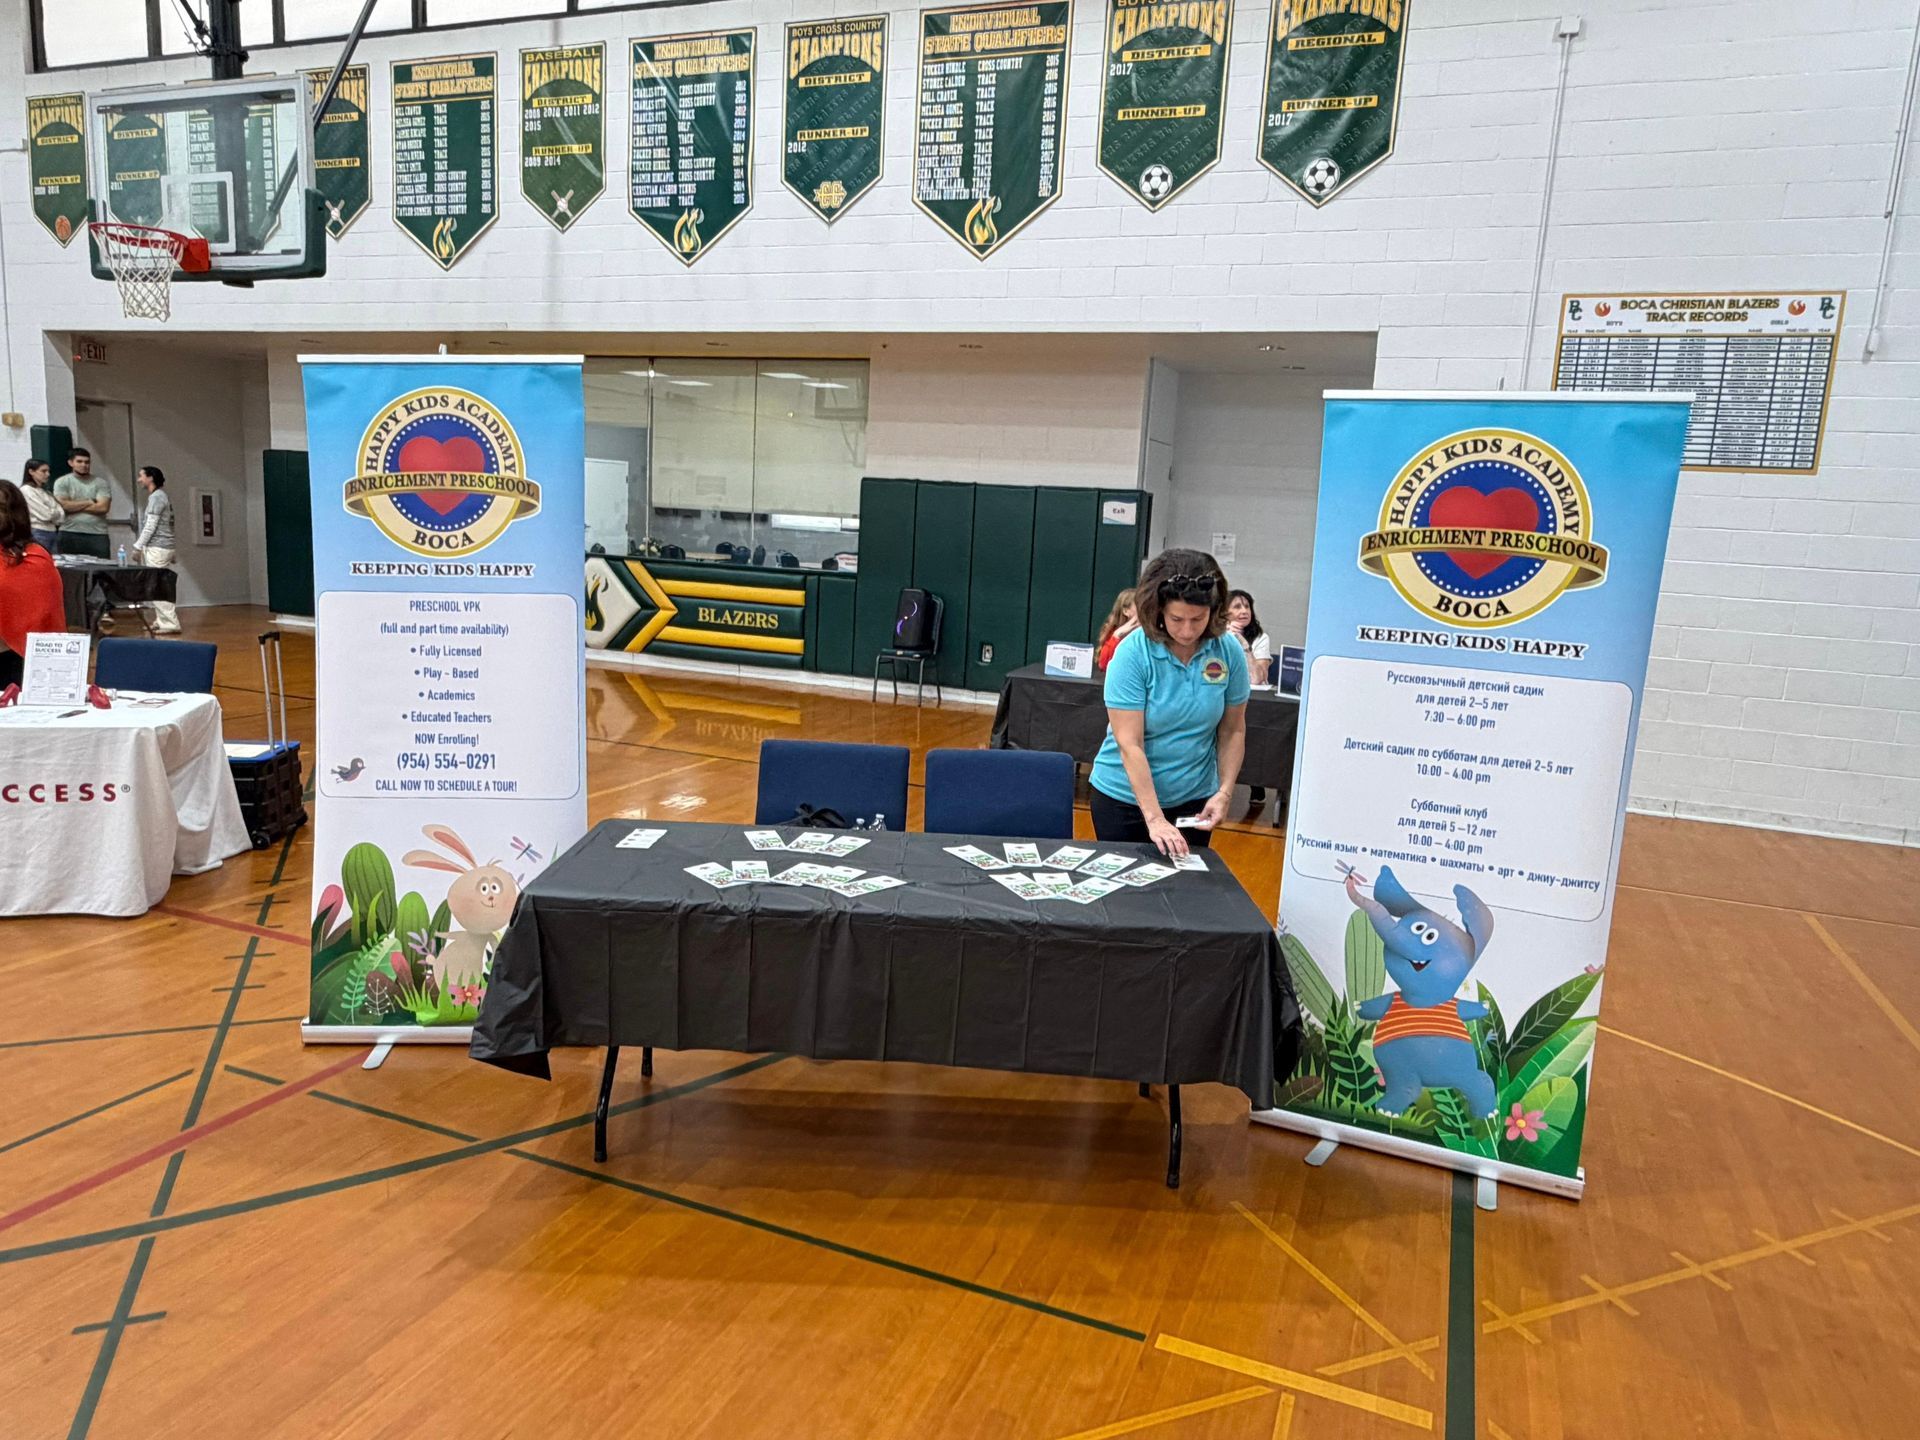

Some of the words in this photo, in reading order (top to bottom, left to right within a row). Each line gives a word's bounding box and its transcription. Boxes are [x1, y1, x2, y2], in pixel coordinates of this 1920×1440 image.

[951, 7, 1040, 32] INDIVIDUAL
[791, 26, 814, 37] BOYS
[815, 23, 842, 35] CROSS
[844, 20, 882, 33] COUNTRY
[1111, 0, 1226, 54] CHAMPIONS
[925, 35, 971, 54] STATE
[974, 25, 1066, 52] QUALIFIERS
[1295, 34, 1377, 48] REGIONAL
[526, 47, 600, 61] BASEBALL
[654, 39, 730, 60] INDIVIDUAL
[790, 31, 881, 80] CHAMPIONS
[1131, 46, 1202, 60] DISTRICT
[978, 59, 995, 71] CROSS
[997, 57, 1023, 70] COUNTRY
[1110, 63, 1133, 76] 2017
[524, 57, 601, 101] CHAMPIONS
[804, 73, 865, 86] DISTRICT
[978, 73, 997, 85] TRACK
[977, 87, 996, 99] TRACK
[536, 96, 587, 107] DISTRICT
[976, 101, 995, 113] TRACK
[1286, 97, 1373, 111] RUNNER-UP
[583, 104, 600, 115] 2012
[1122, 107, 1201, 119] RUNNER-UP
[1268, 113, 1293, 126] 2017
[524, 122, 542, 132] 2015
[799, 128, 867, 140] RUNNER-UP
[787, 142, 807, 153] 2012
[544, 156, 561, 166] 2014
[1619, 300, 1657, 311] BOCA
[1660, 299, 1725, 310] CHRISTIAN
[1728, 298, 1780, 310] BLAZERS
[1646, 312, 1687, 322] TRACK
[1689, 311, 1749, 322] RECORDS
[87, 344, 106, 360] EXIT
[365, 412, 403, 472] HAPPY
[403, 394, 450, 417] KIDS
[454, 397, 516, 475] ACADEMY
[350, 473, 447, 494] ENRICHMENT
[450, 473, 535, 497] PRESCHOOL
[1389, 457, 1439, 526] HAPPY
[1441, 438, 1504, 464] KIDS
[1507, 441, 1580, 537] ACADEMY
[412, 529, 475, 549] BOCA
[1367, 530, 1487, 552] ENRICHMENT
[1490, 531, 1601, 565] PRESCHOOL
[351, 563, 428, 575] KEEPING
[434, 564, 474, 576] KIDS
[479, 565, 534, 576] HAPPY
[409, 601, 461, 612] PRESCHOOL
[463, 601, 481, 612] VPK
[1433, 593, 1513, 619] BOCA
[698, 607, 779, 630] BLAZERS
[380, 622, 398, 635] (full
[400, 623, 417, 634] and
[419, 624, 437, 637] part
[439, 624, 459, 634] time
[460, 624, 509, 637] availability)
[1358, 627, 1449, 646] KEEPING
[1456, 635, 1507, 651] KIDS
[1513, 639, 1587, 658] HAPPY
[420, 646, 440, 658] Fully
[443, 645, 482, 657] Licensed
[423, 667, 442, 680] Play
[452, 667, 479, 679] Based
[1387, 670, 1466, 690] Русскоязычный
[1468, 677, 1510, 694] детский
[1512, 684, 1544, 697] садик
[428, 689, 476, 701] Academics
[1416, 693, 1435, 705] для
[1437, 693, 1466, 707] детей
[1491, 700, 1509, 712] лет
[411, 711, 452, 723] Educated
[454, 712, 492, 724] Teachers
[1480, 718, 1496, 730] pm
[415, 733, 435, 745] NOW
[438, 733, 480, 747] Enrolling!
[397, 753, 430, 771] (954)
[434, 753, 496, 770] 554-0291
[1343, 737, 1384, 754] Детский
[1386, 743, 1415, 757] садик
[1418, 748, 1430, 758] по
[1432, 747, 1478, 765] субботам
[1479, 755, 1500, 767] для
[1501, 756, 1532, 771] детей
[1555, 764, 1574, 776] лет
[1475, 773, 1491, 785] pm
[375, 780, 398, 791] CALL
[400, 780, 421, 791] NOW
[424, 780, 435, 791] TO
[437, 780, 483, 792] SCHEDULE
[484, 781, 491, 792] A
[493, 781, 518, 793] TOUR!
[1410, 798, 1463, 817] Субботний
[1464, 804, 1488, 820] клуб
[1397, 816, 1417, 828] для
[1418, 816, 1447, 831] детей
[1479, 827, 1497, 839] лет
[1467, 843, 1483, 856] pm
[1296, 833, 1332, 852] Русский
[1334, 843, 1358, 855] язык
[1370, 847, 1427, 864] математика
[1439, 858, 1485, 874] шахматы
[1497, 866, 1515, 879] арт
[1526, 871, 1601, 893] джиу-джитсу
